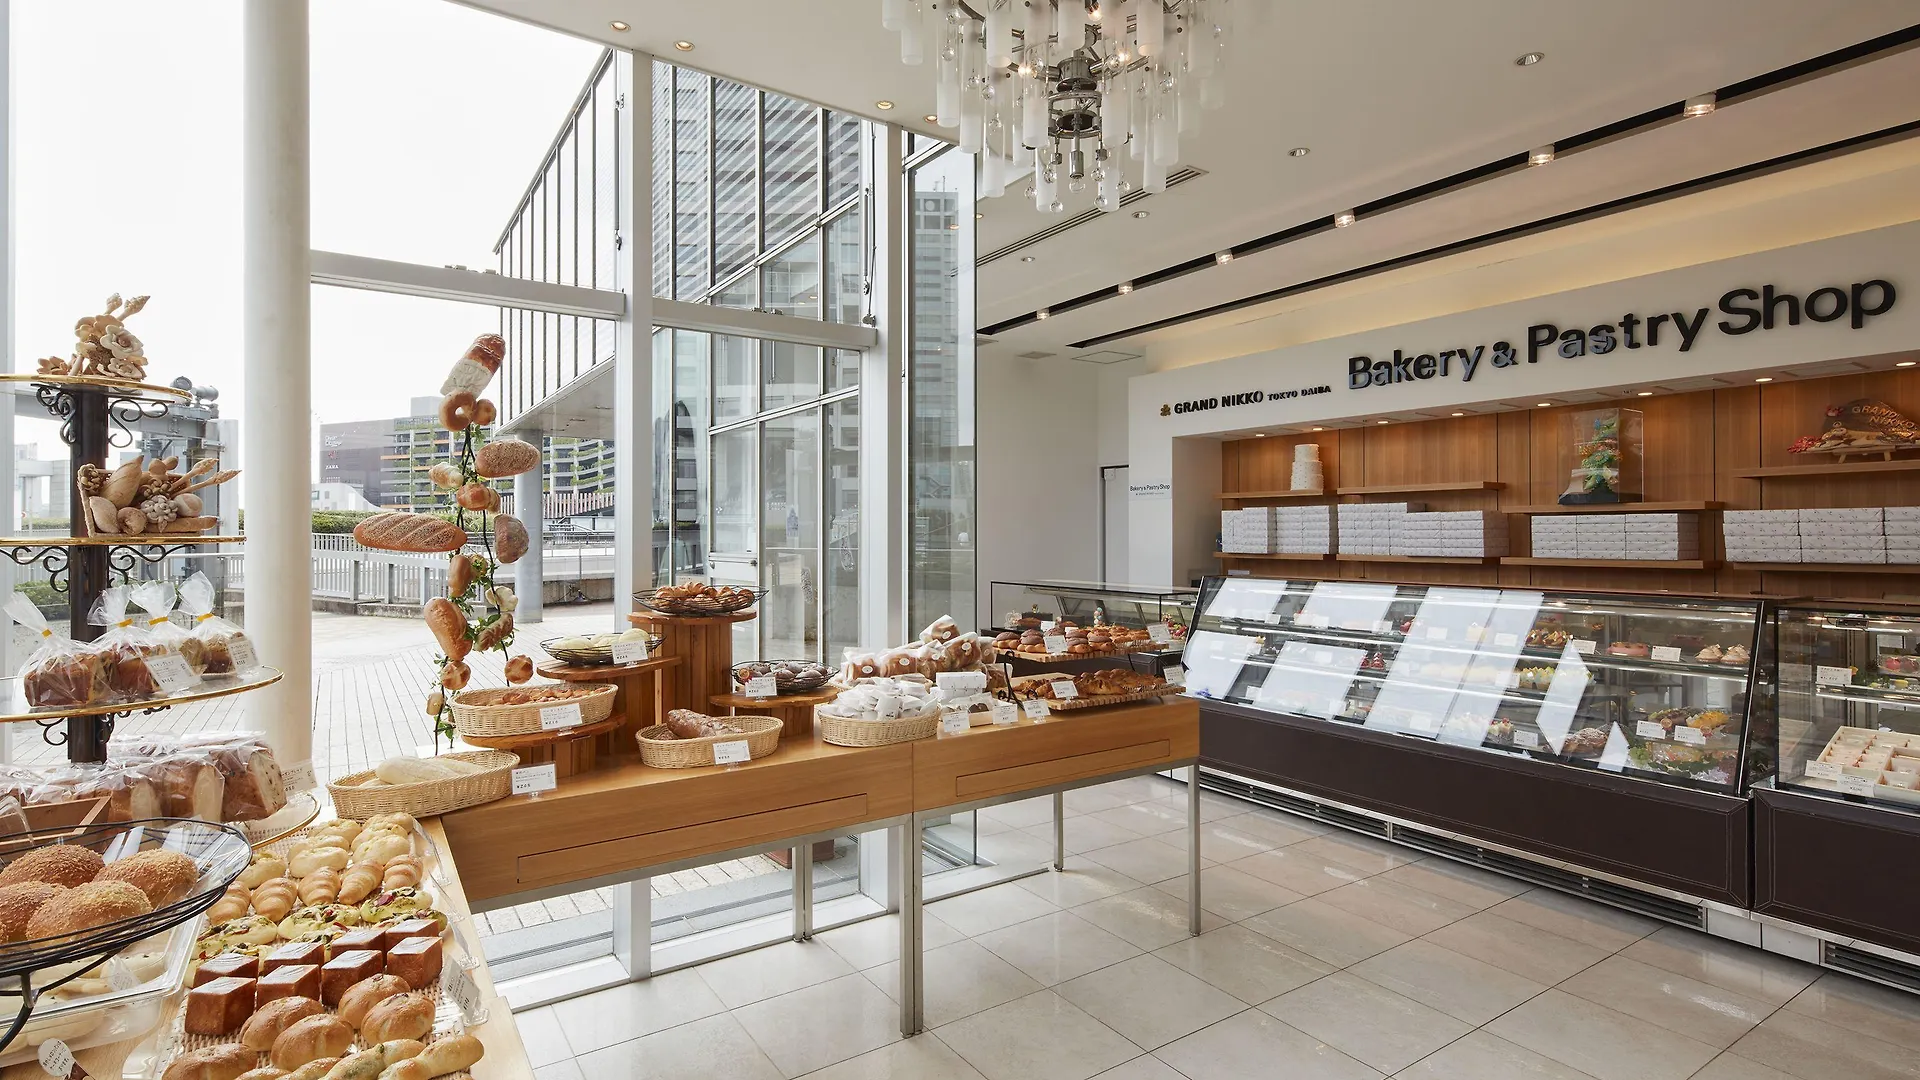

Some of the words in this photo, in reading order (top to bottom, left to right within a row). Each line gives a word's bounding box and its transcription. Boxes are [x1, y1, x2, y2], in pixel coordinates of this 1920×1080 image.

[1348, 345, 1485, 390] Bakery
[1490, 341, 1519, 368] &
[1527, 308, 1710, 364] Pastry
[1717, 279, 1897, 336] Shop
[1173, 397, 1218, 415] GRAND
[1221, 390, 1264, 408] NIKKO
[1267, 390, 1298, 401] TOKYO
[1300, 385, 1332, 397] DAIBA
[1852, 405, 1900, 420] GRAND
[1869, 415, 1915, 429] NIKKO
